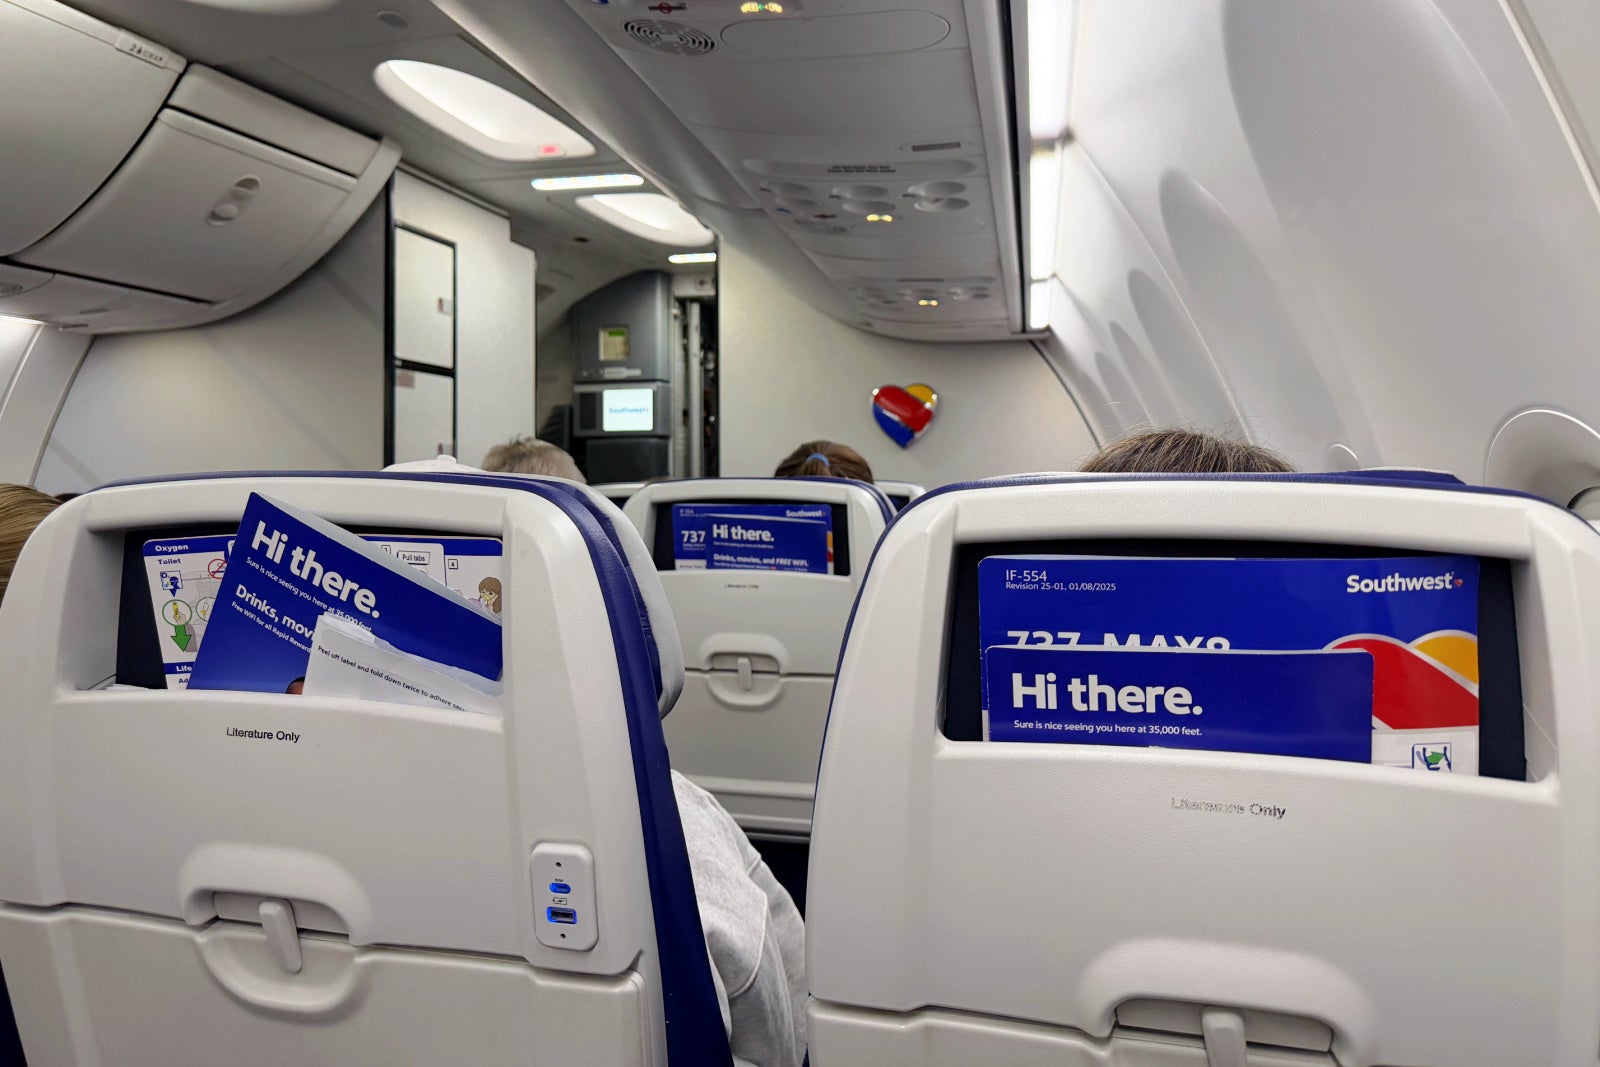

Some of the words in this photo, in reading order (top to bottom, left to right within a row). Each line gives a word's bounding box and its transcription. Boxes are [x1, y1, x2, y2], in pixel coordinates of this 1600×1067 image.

[681, 530, 706, 543] 737
[712, 523, 729, 539] Hi
[730, 525, 775, 542] there.
[155, 544, 189, 553] Oxygen
[402, 553, 413, 561] Pull
[413, 553, 426, 562] tabs
[713, 553, 737, 563] Drinks,
[251, 520, 289, 564] Hi
[290, 546, 380, 619] there.
[1005, 569, 1048, 582] IF-554
[246, 556, 260, 571] Sure
[260, 565, 266, 574] is
[265, 570, 279, 581] nice
[278, 578, 300, 595] seeing
[299, 590, 312, 601] you
[312, 596, 328, 610] here
[1005, 581, 1039, 590] Revision
[1041, 582, 1067, 591] 25-01,
[1068, 582, 1117, 592] 01/08/2025
[1346, 572, 1453, 593] Southwest
[236, 583, 279, 623] Drinks,
[231, 601, 244, 613] Free
[256, 617, 265, 627] for
[264, 623, 273, 631] all
[272, 626, 290, 641] Rapid
[317, 644, 331, 657] Peel
[340, 656, 357, 668] label
[356, 663, 370, 674] and
[370, 668, 384, 679] fold
[383, 674, 402, 686] down
[402, 682, 421, 694] twice
[421, 689, 429, 698] to
[429, 692, 452, 707] adhere
[1011, 672, 1058, 711] Hi
[1066, 673, 1204, 717] there.
[226, 726, 274, 741] Literature
[275, 730, 301, 744] Only
[1013, 718, 1034, 730] Sure
[1035, 719, 1043, 731] is
[1044, 720, 1063, 732] nice
[1064, 721, 1094, 735] seeing
[1095, 723, 1113, 735] you
[1114, 722, 1136, 735] here
[1137, 724, 1147, 735] at
[1148, 724, 1180, 738] 35,000
[1181, 725, 1203, 737] feet.
[1248, 802, 1286, 820] Only
